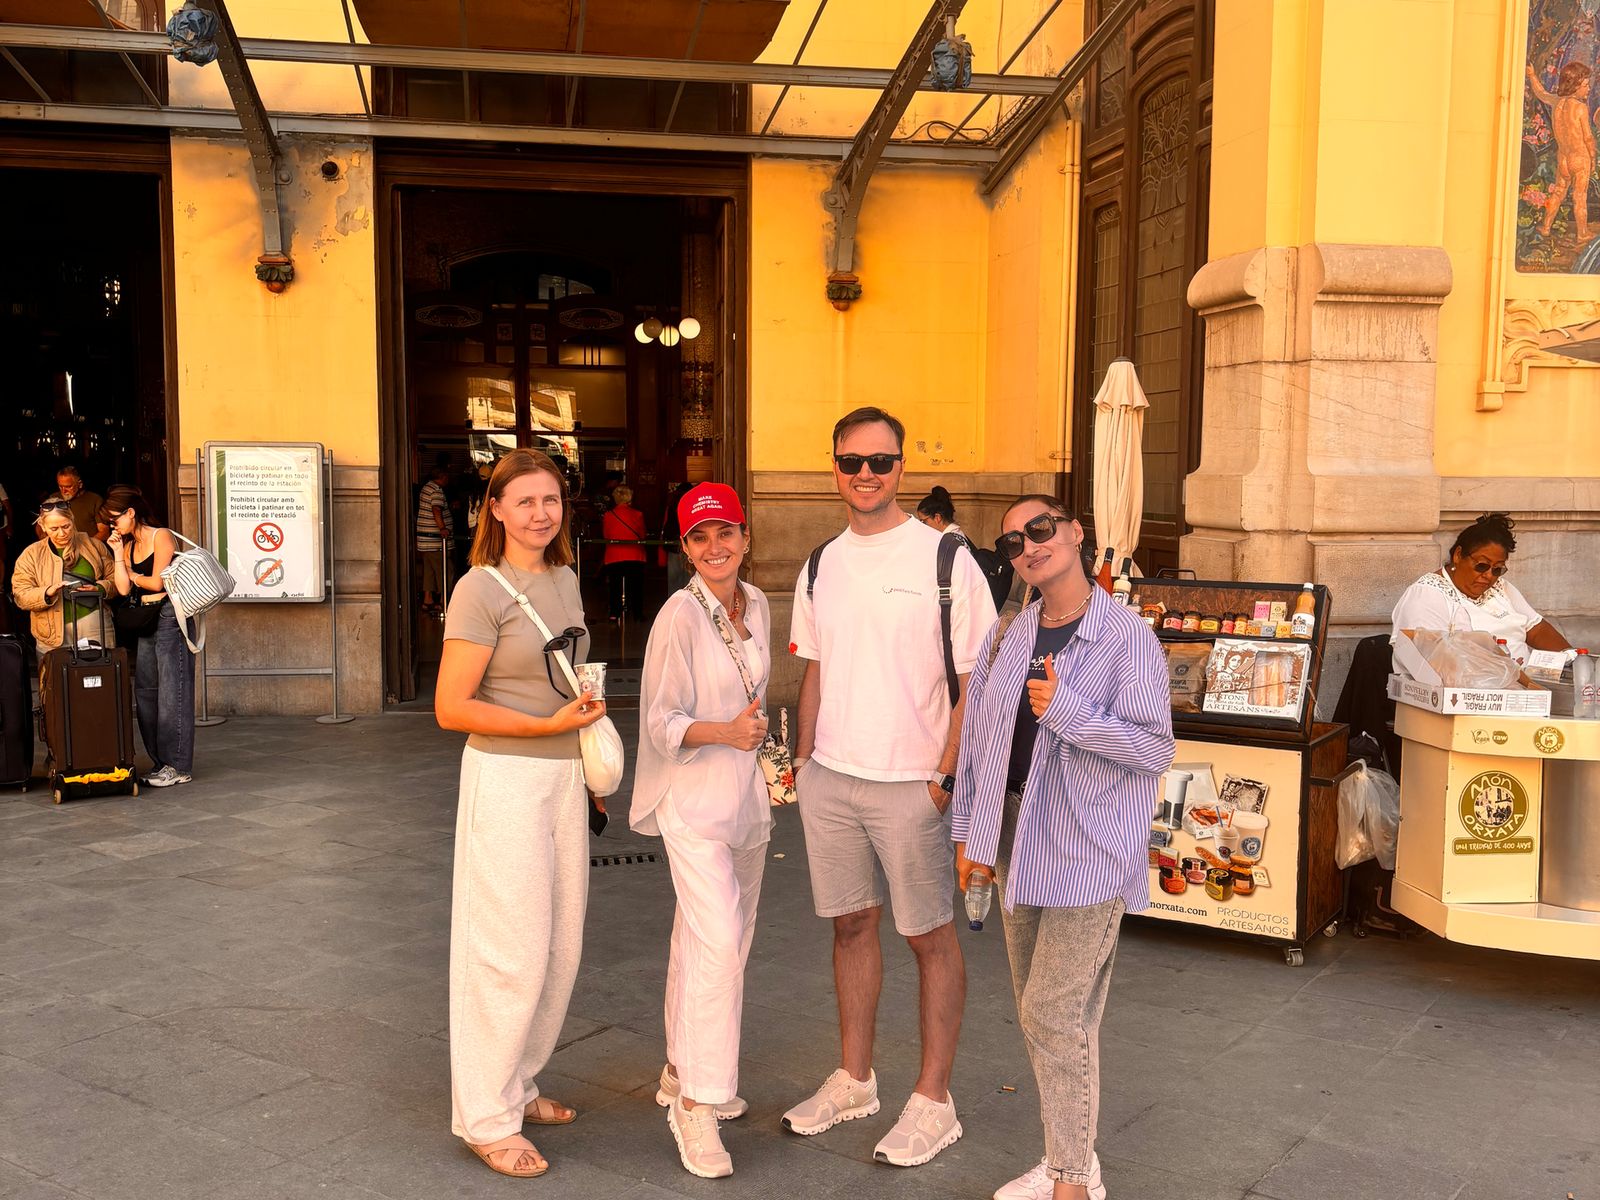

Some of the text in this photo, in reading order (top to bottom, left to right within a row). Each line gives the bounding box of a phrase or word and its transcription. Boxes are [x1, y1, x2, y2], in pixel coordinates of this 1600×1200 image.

[1486, 694, 1503, 702] MOLT
[1206, 703, 1260, 713] ARTESANS
[1488, 702, 1502, 711] MUY
[1536, 742, 1562, 752] ORXATA
[1464, 814, 1523, 838] ORXATA
[1217, 907, 1289, 925] PRODUCTOS
[1219, 918, 1289, 936] ARTESANOS
